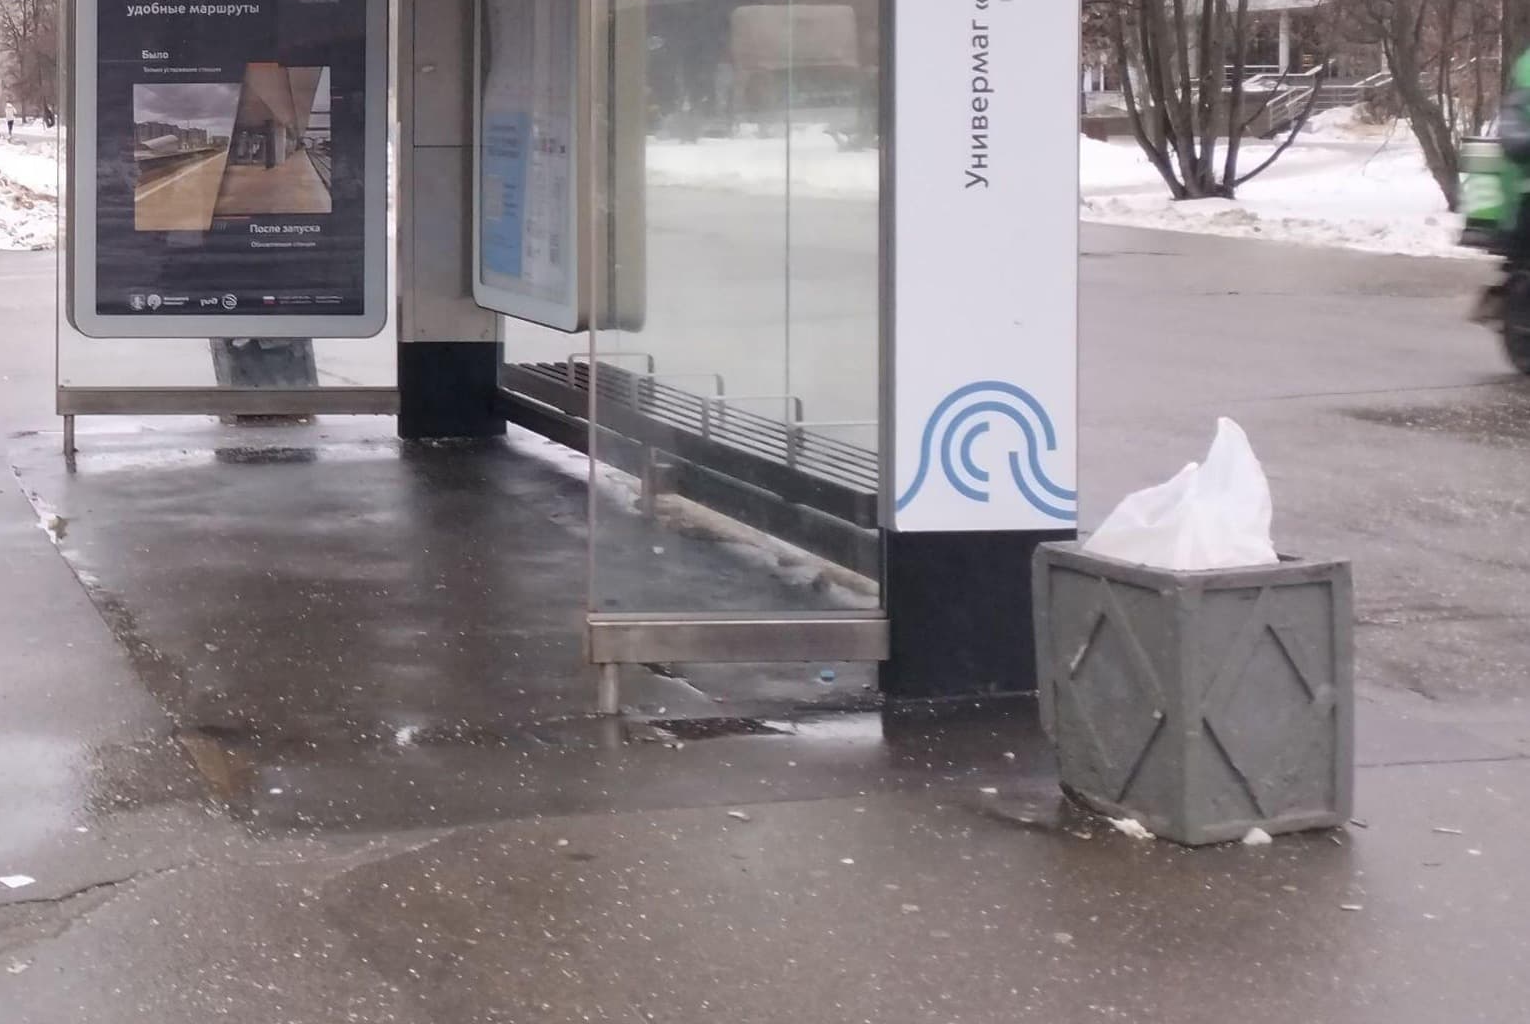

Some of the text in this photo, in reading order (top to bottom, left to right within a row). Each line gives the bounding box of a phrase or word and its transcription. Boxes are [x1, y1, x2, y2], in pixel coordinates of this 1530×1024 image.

[127, 2, 260, 16] удобные маршруты
[141, 50, 169, 59] Было
[964, 18, 989, 189] Универмаг
[250, 224, 321, 234] После запуска
